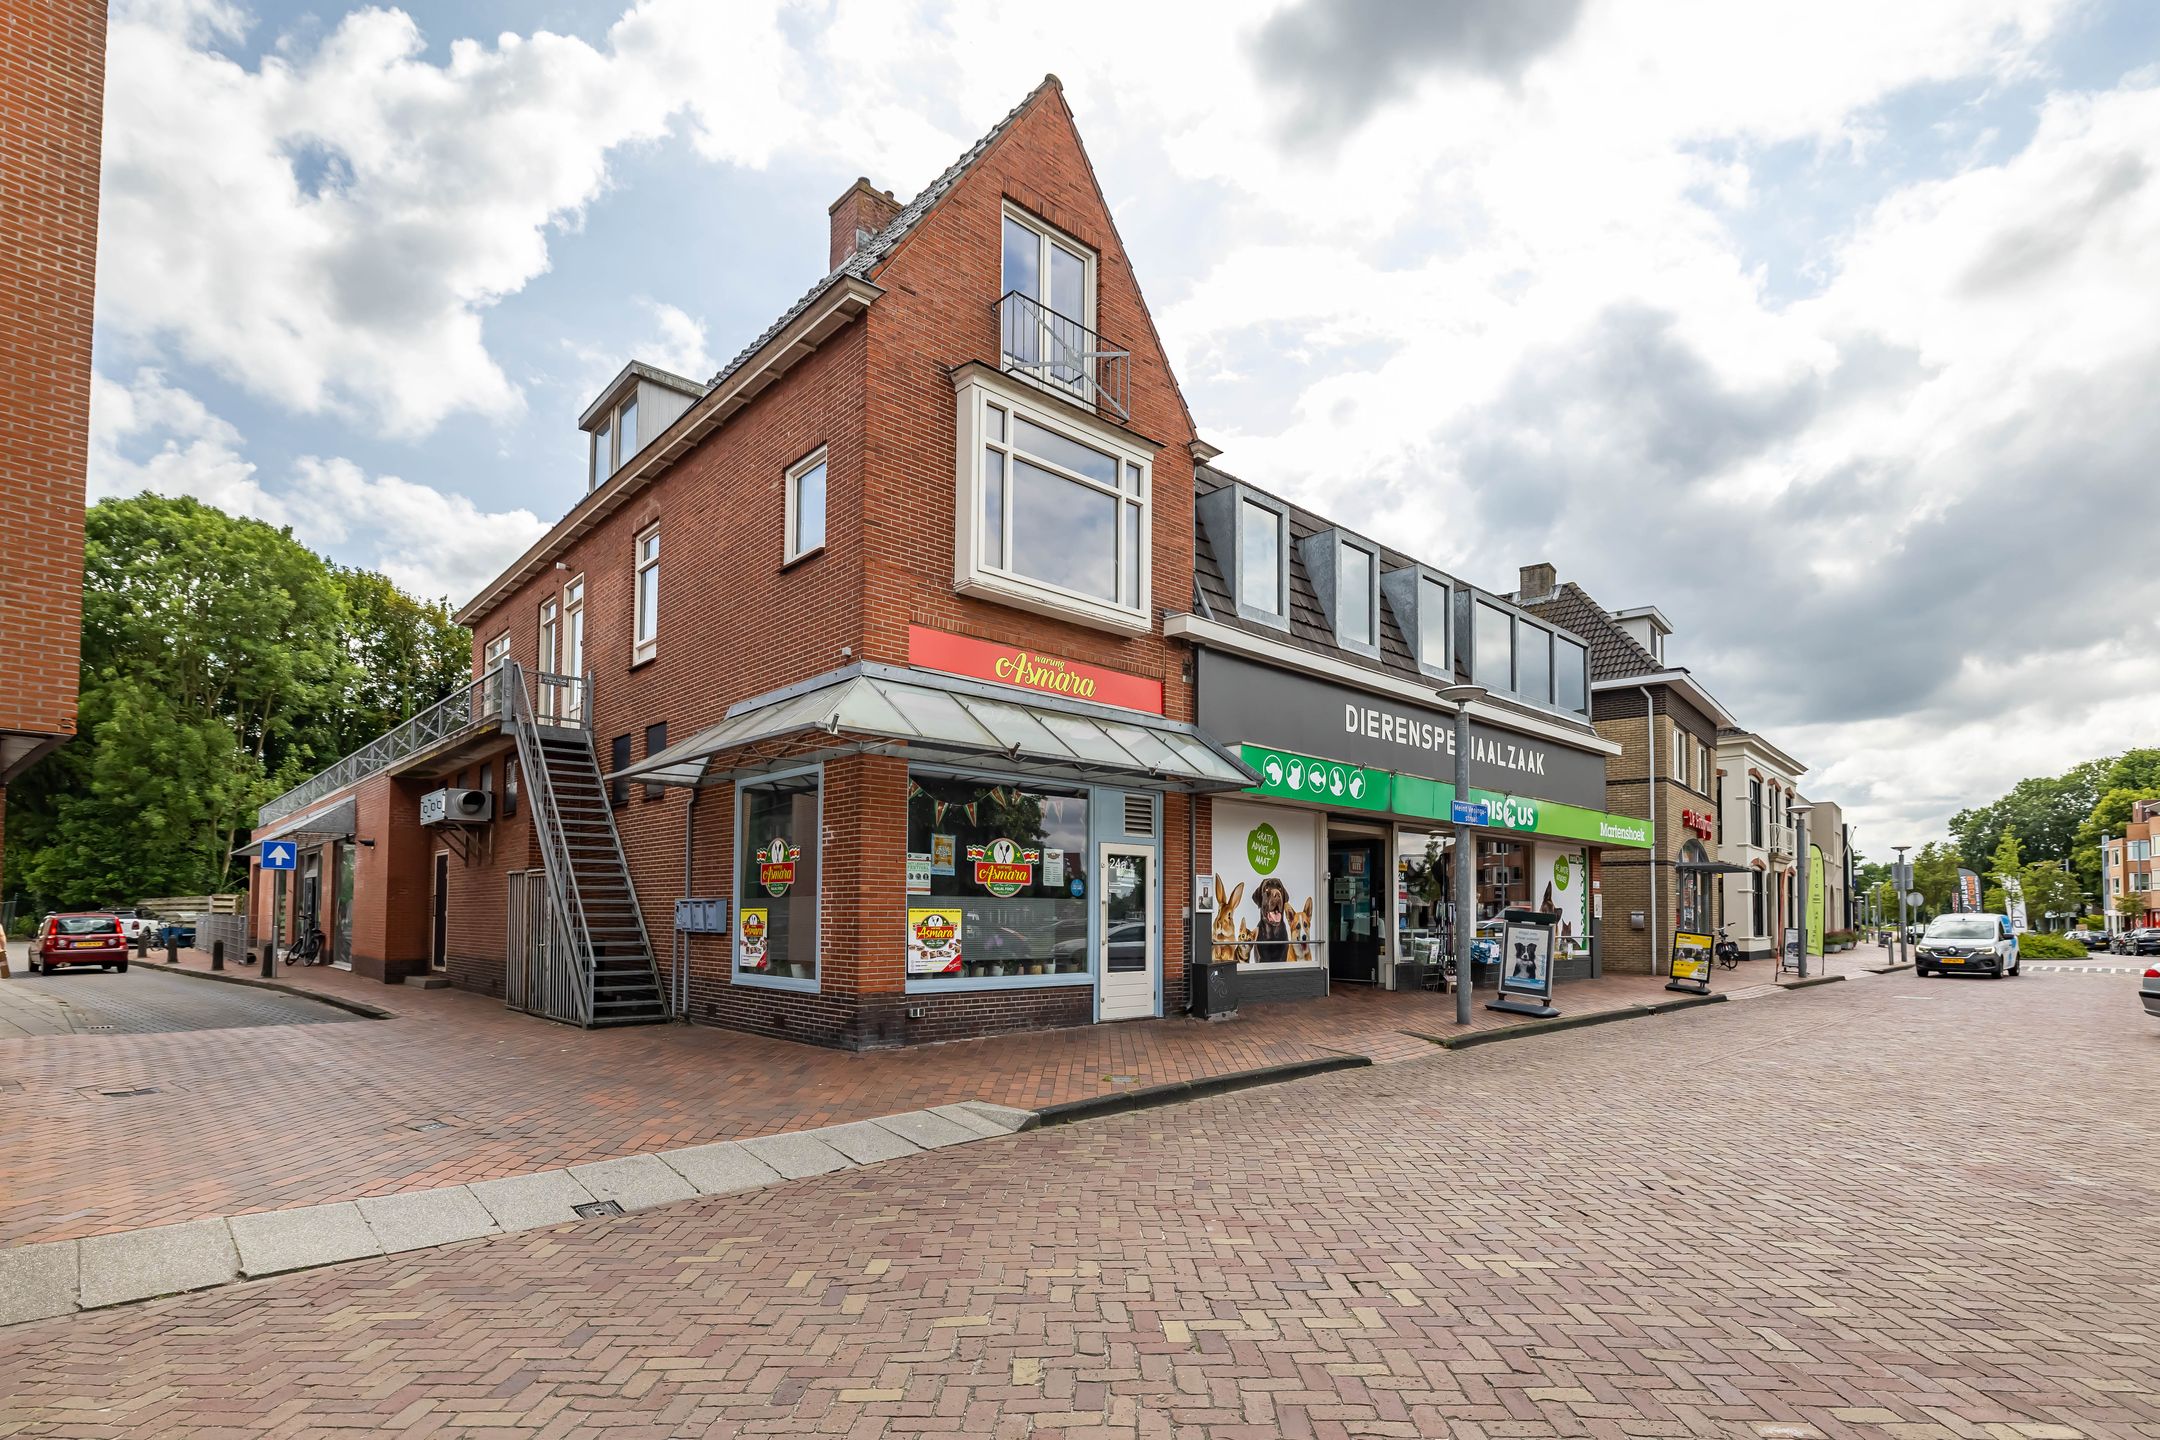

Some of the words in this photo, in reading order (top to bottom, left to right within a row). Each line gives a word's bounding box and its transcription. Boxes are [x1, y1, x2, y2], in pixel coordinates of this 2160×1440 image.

[1034, 655, 1065, 672] warung
[995, 653, 1097, 697] Asmara
[1345, 703, 1545, 776] DIERENSPEIAALZAAK
[1256, 831, 1273, 845] GRATIS
[1600, 822, 1646, 841] Martenshoek
[1251, 841, 1268, 855] ADVIES
[1109, 857, 1127, 869] 24a
[1255, 855, 1271, 867] MAAT
[979, 865, 1028, 888] Asmara
[917, 926, 953, 939] Asmara
